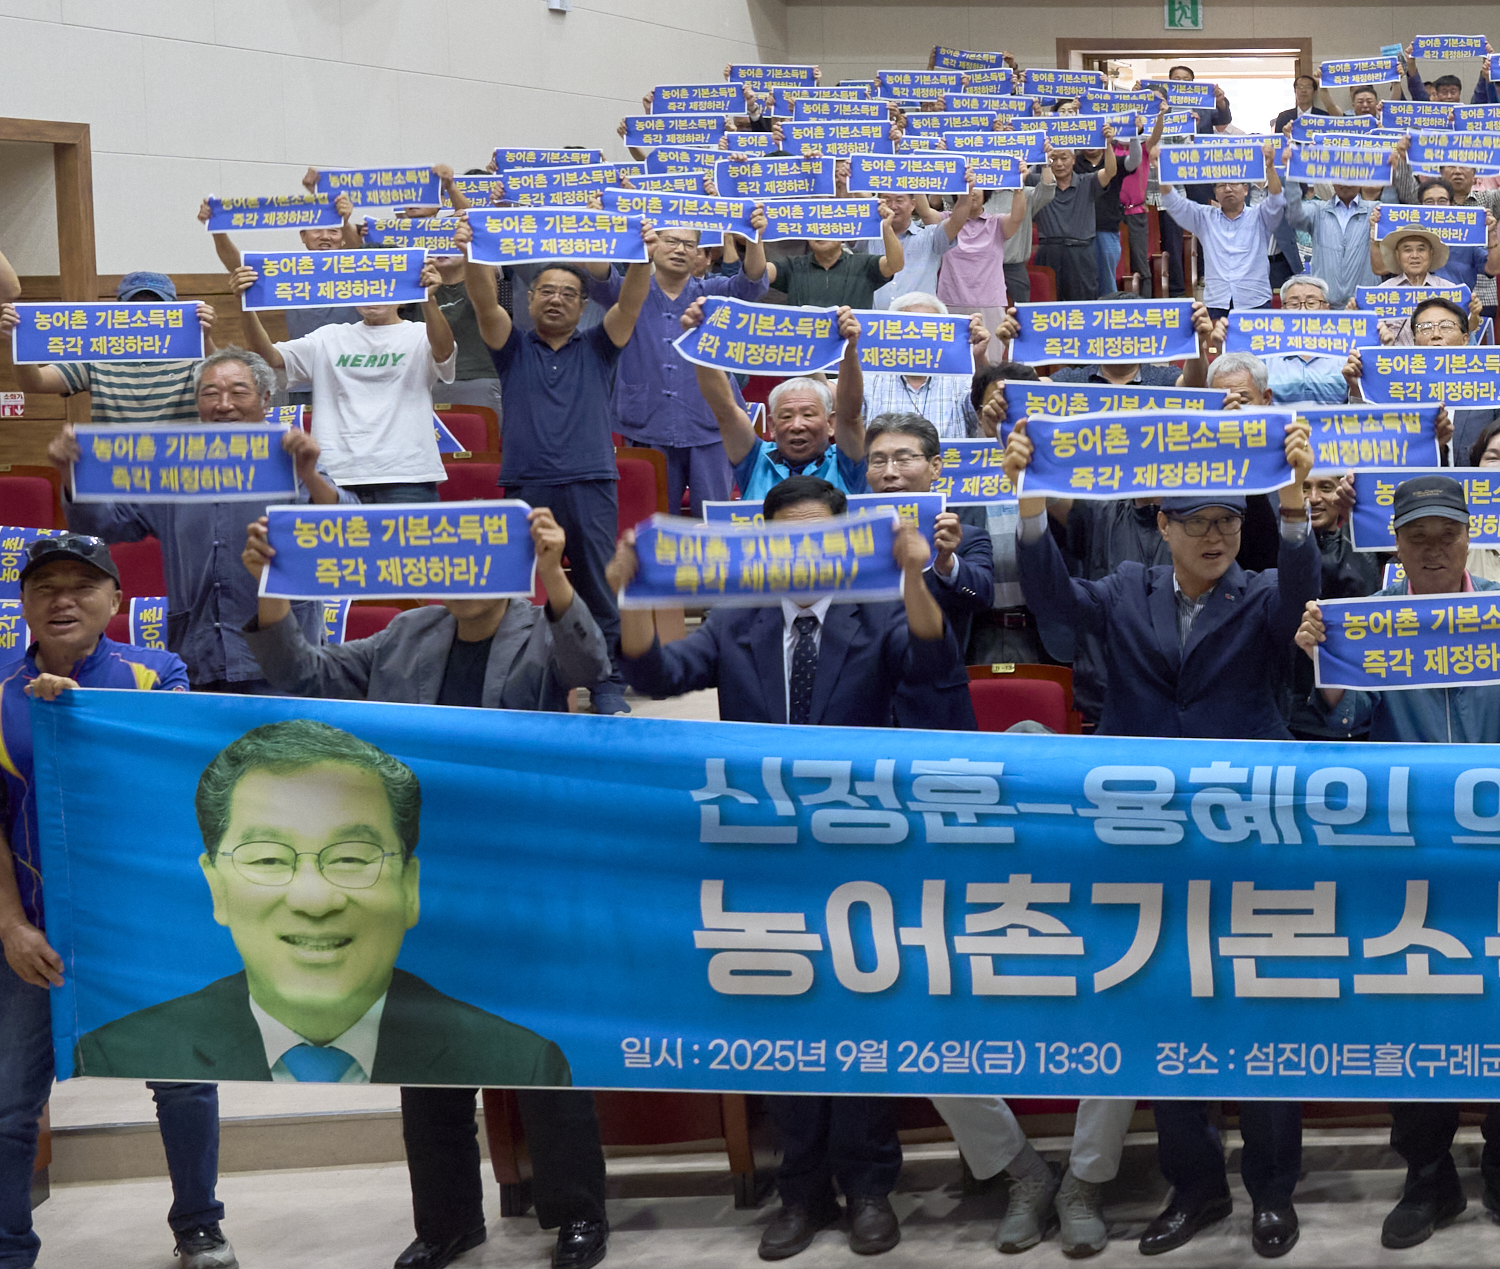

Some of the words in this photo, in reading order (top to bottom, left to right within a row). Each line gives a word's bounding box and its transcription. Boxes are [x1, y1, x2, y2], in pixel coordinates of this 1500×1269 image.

[1328, 63, 1351, 74] 농어촌
[1355, 60, 1391, 71] 기본소득법
[1333, 75, 1350, 84] 즉각
[1352, 73, 1387, 83] 제정하라!
[662, 88, 688, 99] 농어촌
[693, 87, 737, 98] 기본소득법
[667, 102, 686, 110] 즉각
[689, 101, 730, 110] 제정하라!
[862, 159, 896, 172] 농어촌
[901, 160, 956, 173] 기본소득법
[1170, 149, 1200, 164] 농어촌
[1204, 148, 1254, 162] 기본소득법
[1177, 166, 1198, 178] 즉각
[1201, 165, 1246, 178] 제정하라!
[869, 175, 892, 188] 즉각
[896, 176, 948, 189] 제정하라!
[766, 205, 803, 219] 농어촌
[809, 204, 870, 219] 기본소득법
[485, 214, 536, 233] 농어촌
[545, 214, 627, 233] 기본소득법
[777, 222, 802, 234] 즉각
[807, 222, 862, 236] 제정하라!
[500, 237, 534, 256] 즉각
[541, 238, 616, 255] 제정하라!
[262, 256, 314, 277] 농어촌
[322, 254, 407, 274] 기본소득법
[275, 282, 311, 301] 즉각
[317, 279, 396, 299] 제정하라!
[34, 309, 88, 331] 농어촌
[96, 309, 183, 329] 기본소득법
[1032, 309, 1085, 332] 농어촌
[1093, 308, 1179, 329] 기본소득법
[47, 336, 83, 355] 즉각
[90, 335, 171, 355] 제정하라!
[1044, 337, 1080, 357] 즉각
[1087, 336, 1167, 357] 제정하라!
[335, 352, 406, 368] NERDY
[1376, 353, 1427, 375] 농어촌
[1389, 381, 1422, 401] 즉각
[1051, 423, 1130, 457] 농어촌
[1140, 419, 1267, 452] 기본소득법
[1069, 465, 1123, 490] 즉각
[1132, 459, 1250, 487] 제정하라!
[293, 516, 371, 548] 농어촌
[381, 514, 508, 546] 기본소득법
[315, 558, 367, 588] 즉각
[376, 555, 491, 587] 제정하라!
[1342, 607, 1420, 640] 농어촌
[1362, 648, 1414, 678] 즉각
[691, 756, 1415, 846] 신정훈-용혜인
[621, 1037, 683, 1070] 일시
[708, 1038, 826, 1072] 2025년
[835, 1039, 888, 1073] 9월
[897, 1040, 1026, 1075] 26일(금)
[1035, 1041, 1122, 1075] 13:30
[1156, 1042, 1219, 1075] 장소
